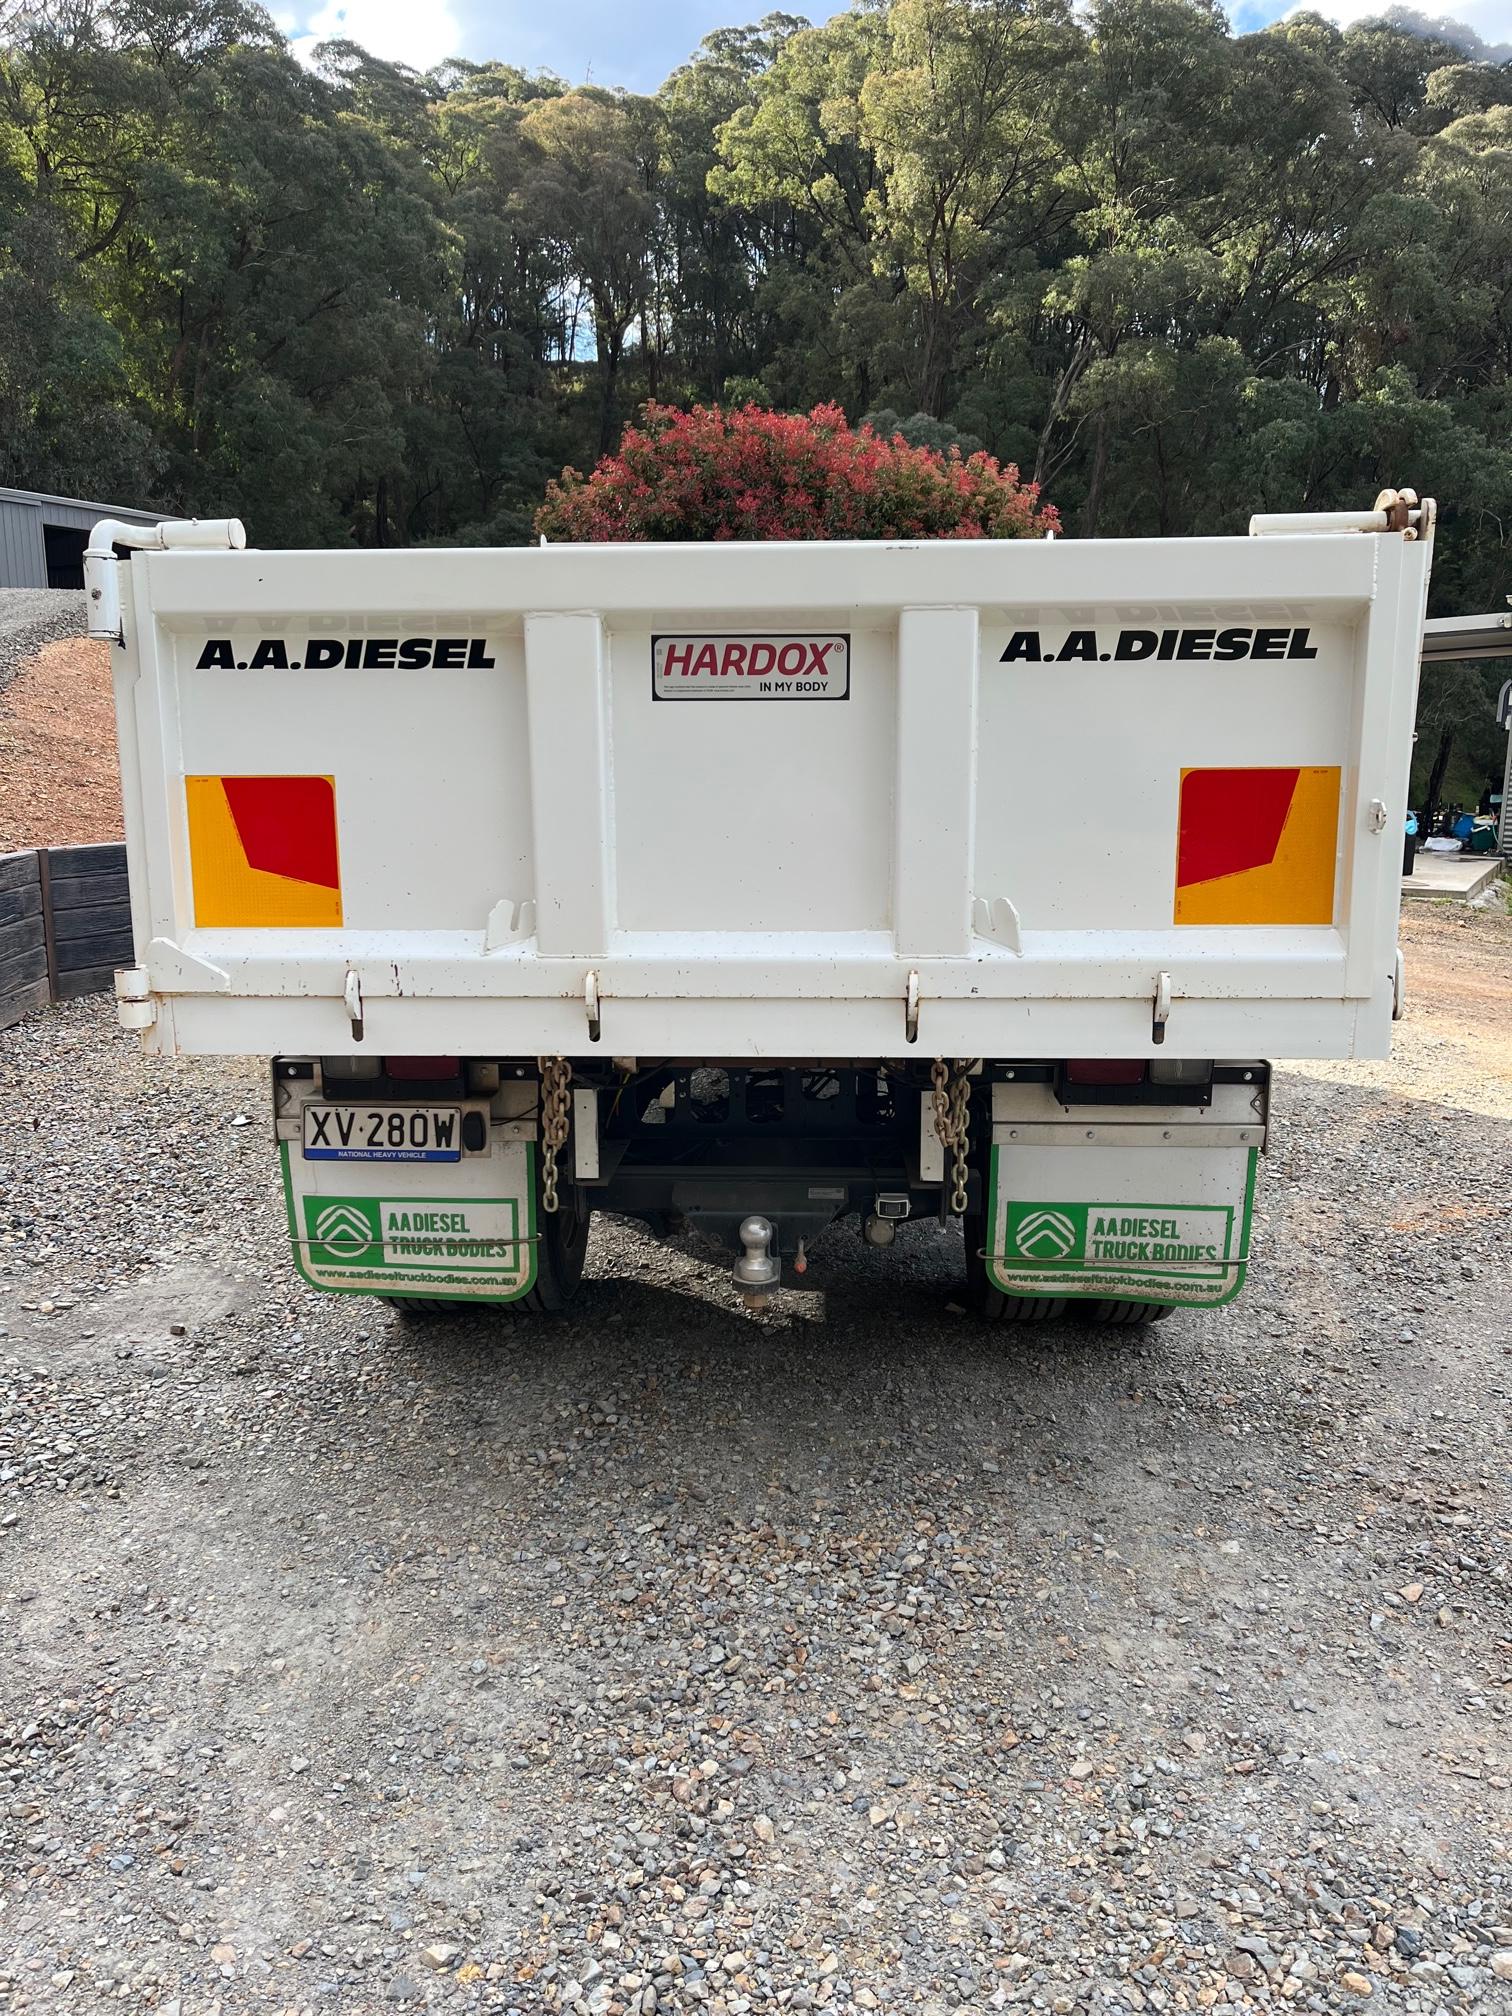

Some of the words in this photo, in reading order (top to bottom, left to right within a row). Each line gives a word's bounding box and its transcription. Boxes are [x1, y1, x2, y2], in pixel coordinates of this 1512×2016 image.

[195, 638, 496, 670] A.A.DIESEL
[998, 628, 1319, 662] A.A.DIESEL
[759, 682, 772, 692] IN
[774, 682, 793, 692] MY
[795, 681, 828, 692] BODY
[1092, 1240, 1151, 1260] TRUCK
